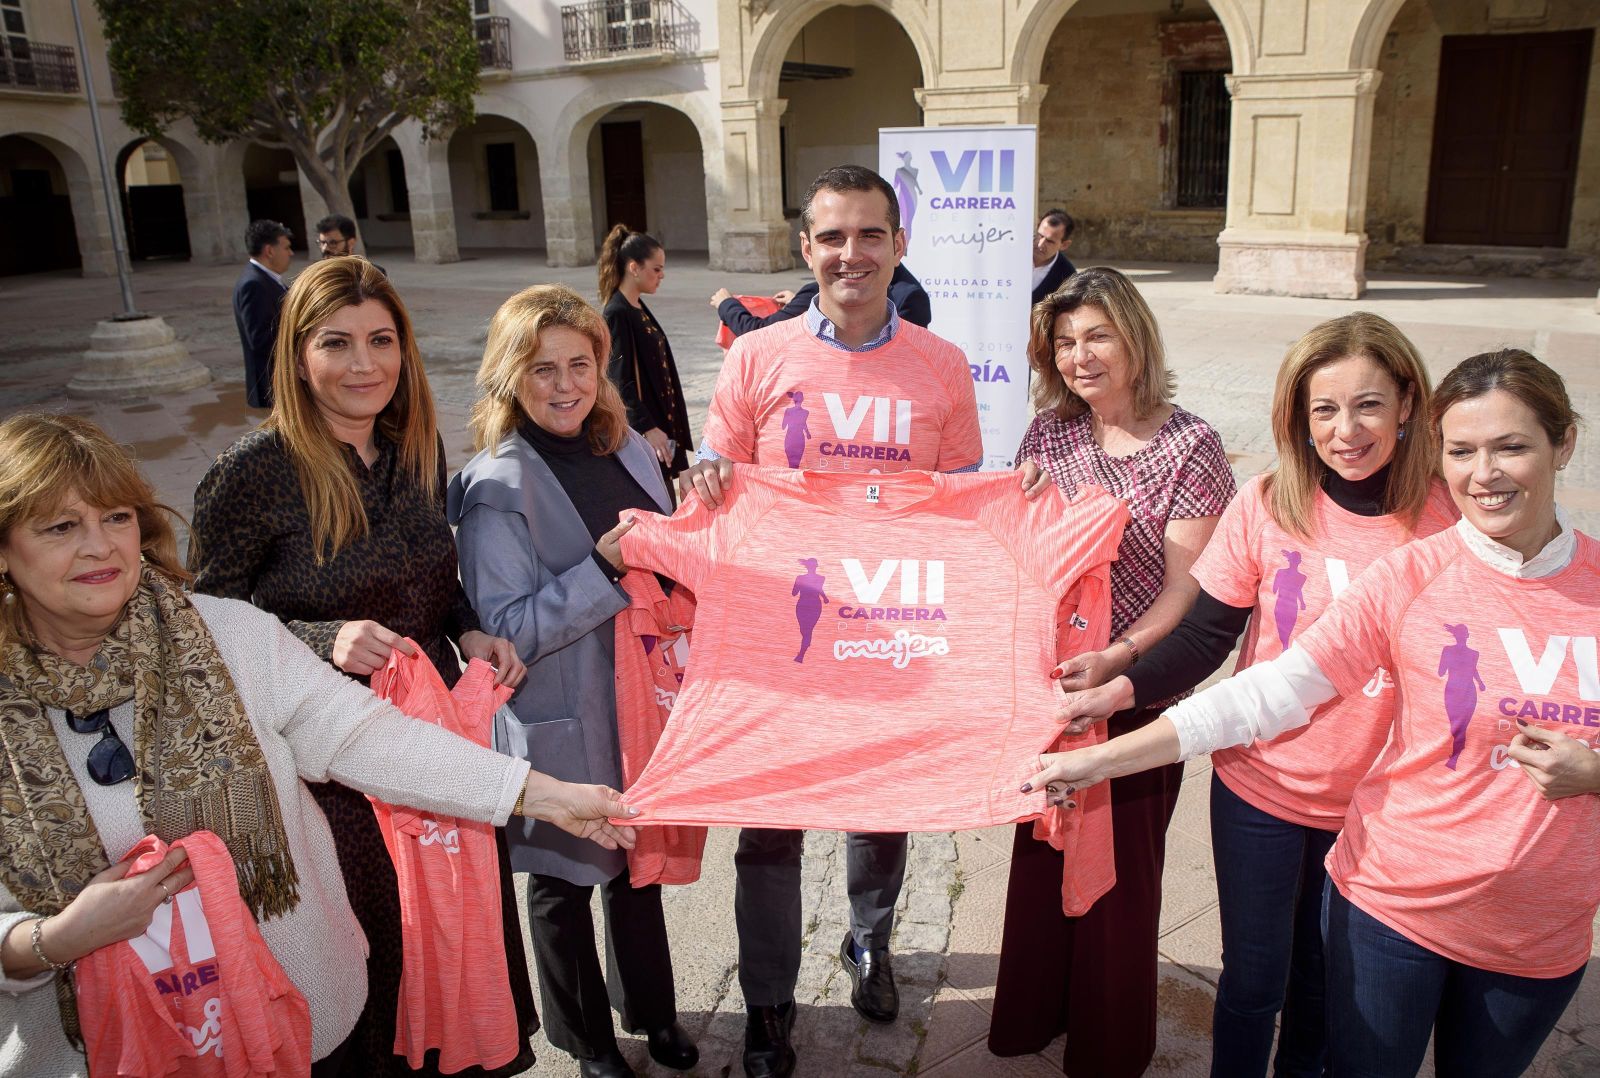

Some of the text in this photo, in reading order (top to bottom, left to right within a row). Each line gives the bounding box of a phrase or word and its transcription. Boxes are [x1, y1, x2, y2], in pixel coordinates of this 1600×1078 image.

[930, 149, 1015, 193] VII
[930, 197, 1016, 210] CARRERA
[997, 279, 1013, 287] ES
[927, 290, 959, 299] STRA
[978, 342, 1014, 353] 2019
[969, 359, 1011, 383] RÍA
[822, 392, 912, 445] VII
[819, 442, 912, 462] CARRERA
[819, 458, 851, 470] DE
[840, 558, 945, 605] VII
[838, 606, 947, 621] CARRERA
[837, 622, 946, 632] DE LA
